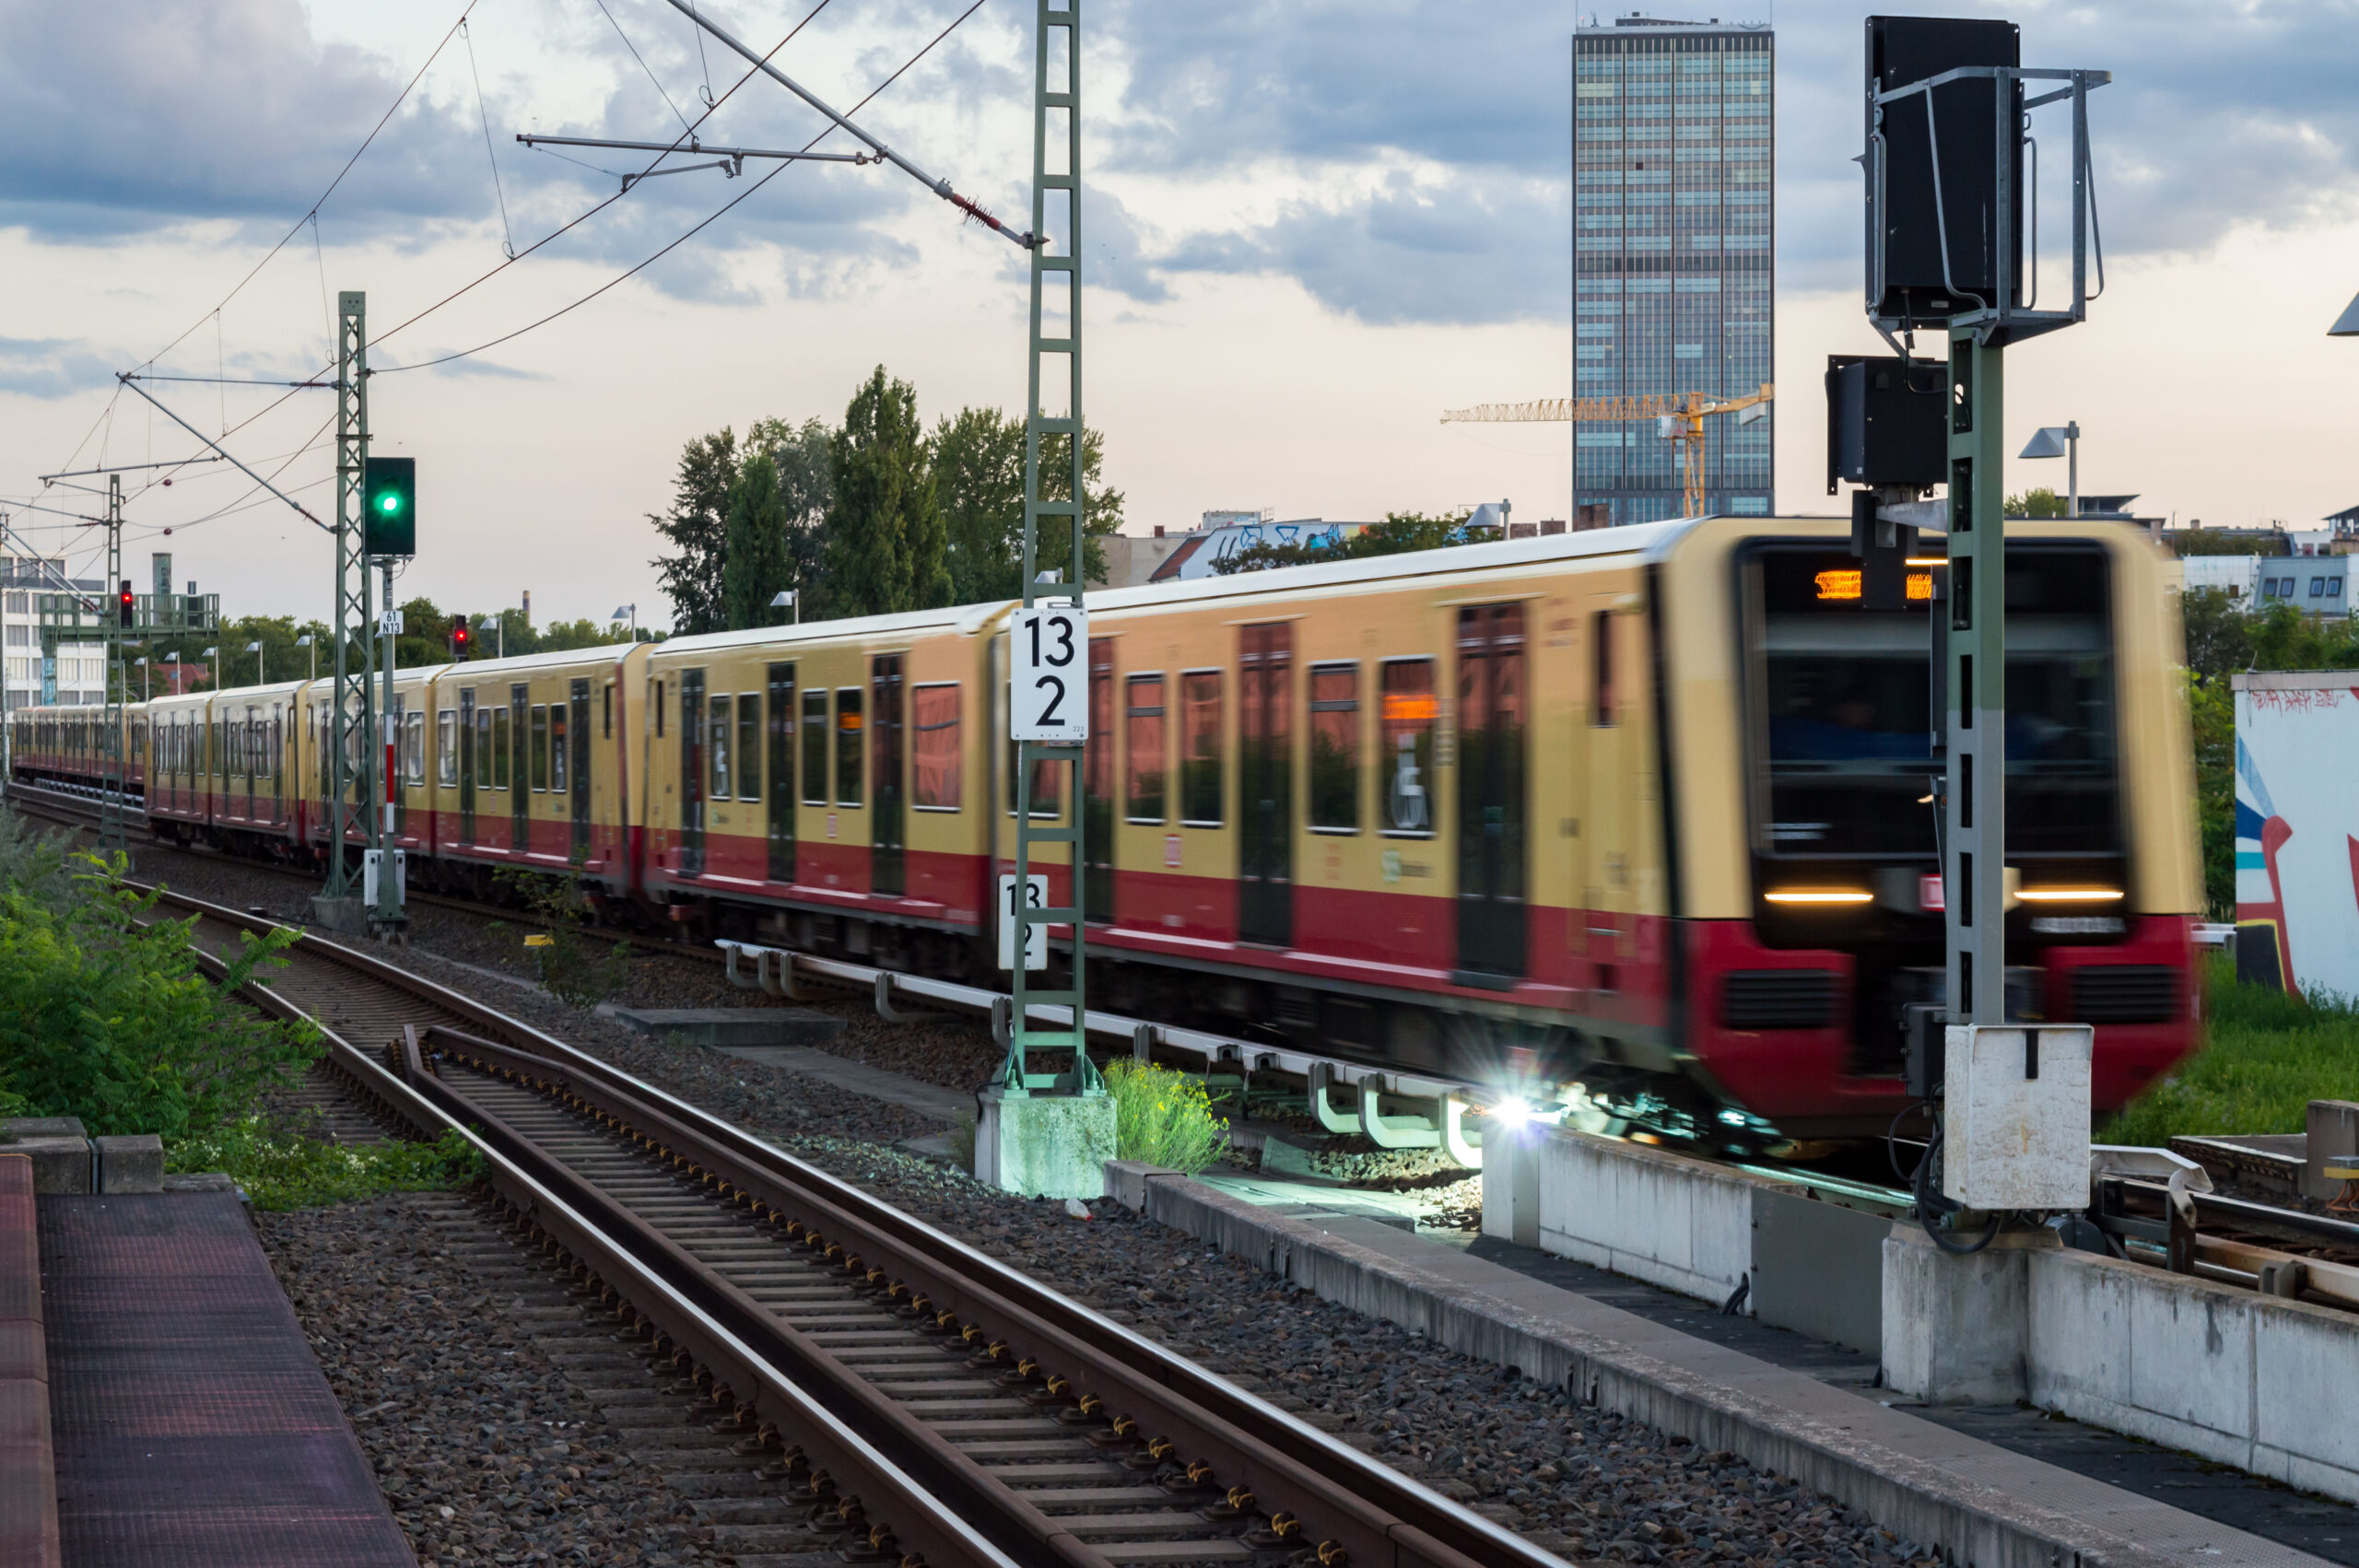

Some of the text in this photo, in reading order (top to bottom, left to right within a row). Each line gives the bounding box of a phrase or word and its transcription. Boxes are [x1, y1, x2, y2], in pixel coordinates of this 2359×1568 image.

[383, 623, 400, 634] N13
[387, 612, 396, 622] 61
[1025, 616, 1074, 667] 13
[1035, 675, 1065, 726] 2
